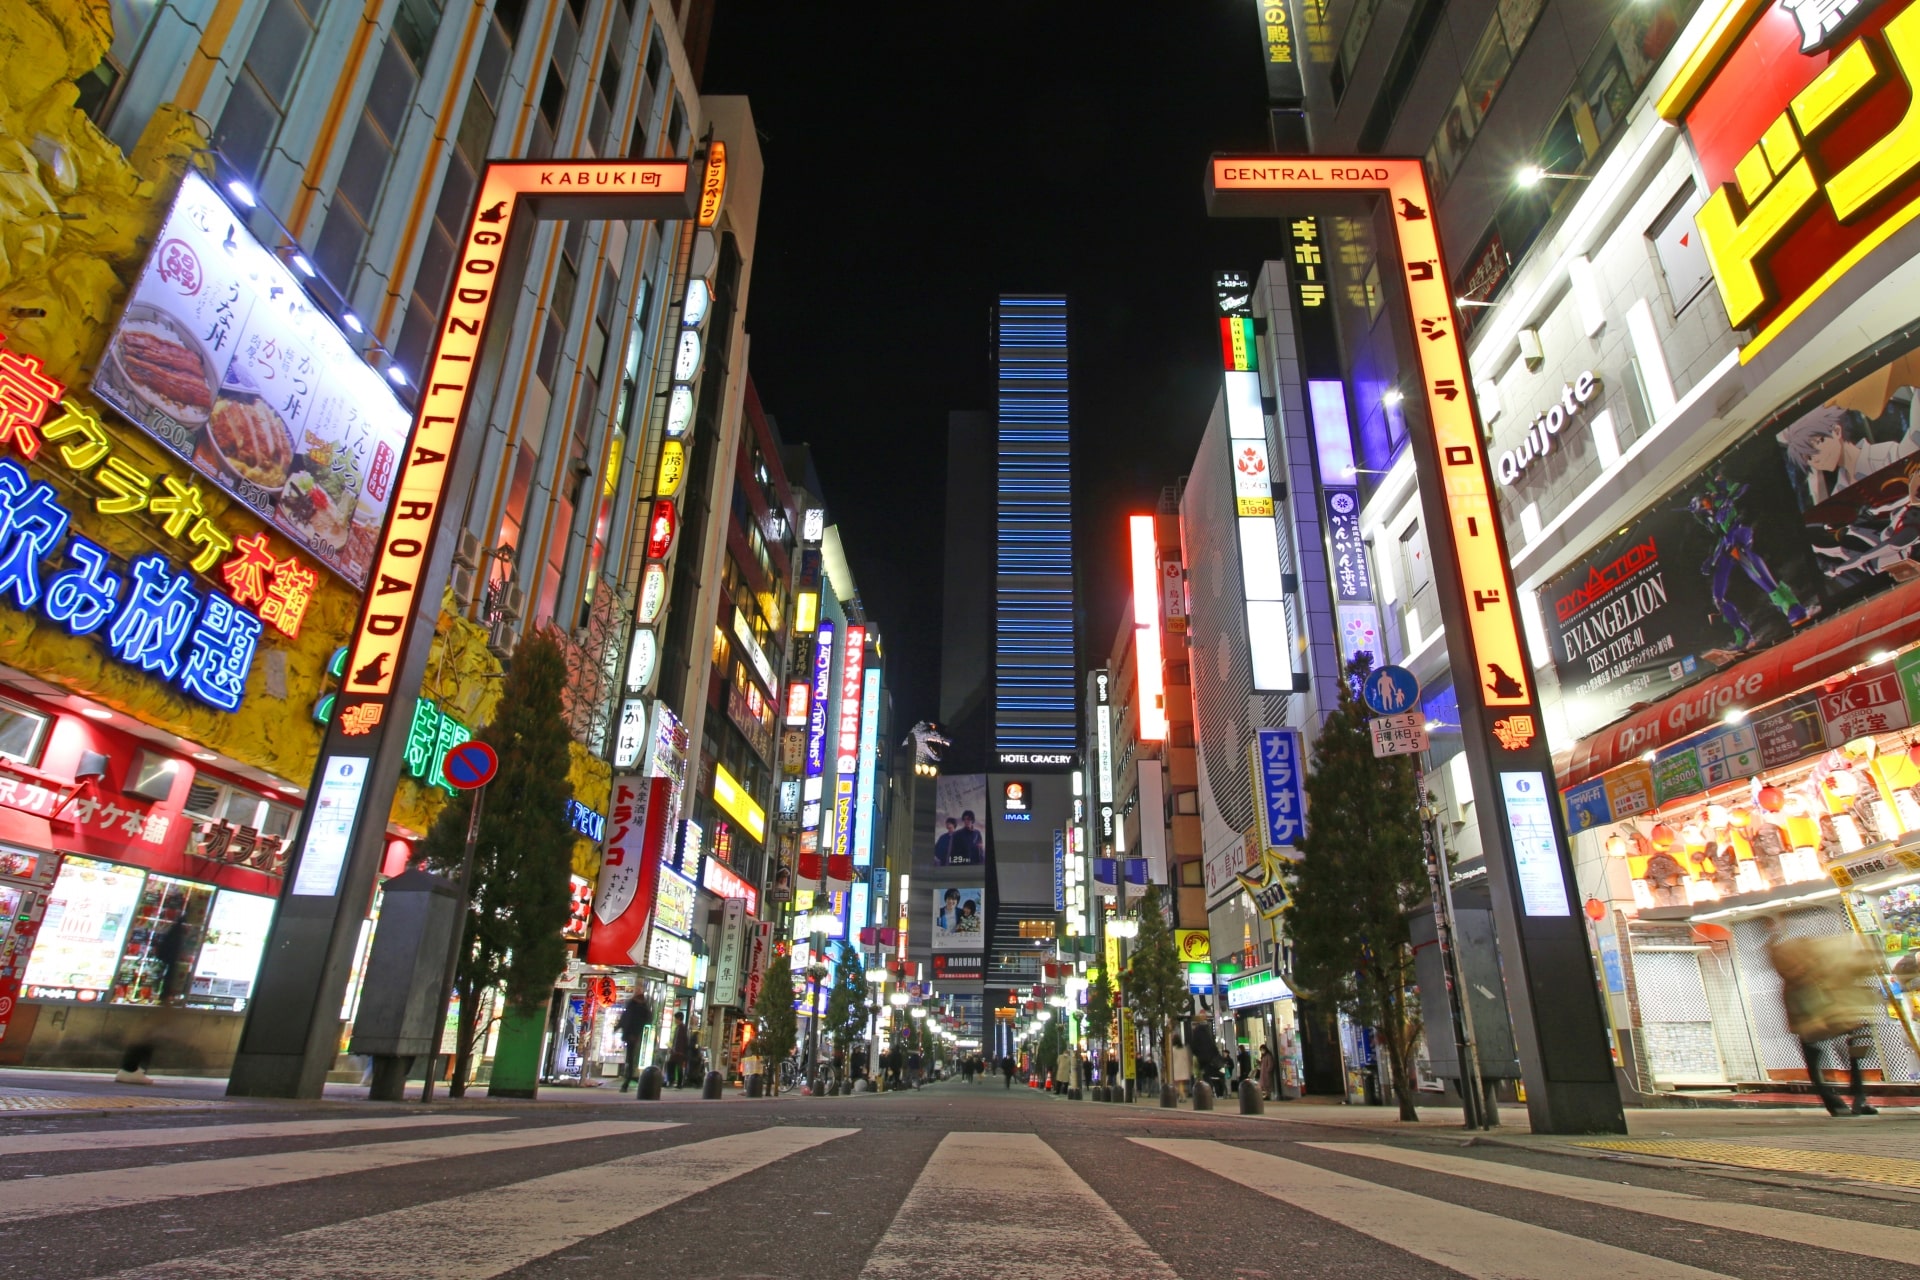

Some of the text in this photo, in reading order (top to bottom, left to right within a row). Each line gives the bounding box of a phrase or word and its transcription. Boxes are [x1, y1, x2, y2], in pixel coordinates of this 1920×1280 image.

[1224, 168, 1389, 181] CENTRAL ROAD
[205, 281, 240, 351] うな丼
[257, 338, 282, 380] かつ
[282, 357, 314, 419] かつ丼
[332, 407, 358, 472] ラーメン
[366, 231, 502, 636] GODZILLA ROAD
[1407, 259, 1500, 612] ゴジラロード
[1498, 370, 1594, 486] Quijote
[1332, 515, 1358, 596] かんかん商店
[1562, 572, 1668, 663] EVANGELION
[1587, 627, 1645, 674] TEST TYPE-01
[809, 708, 824, 759] SHINJUKU
[1618, 673, 1763, 754] Don Quijote
[1839, 712, 1889, 740] 資生堂
[1001, 754, 1072, 764] HOTEL GRACERY
[632, 779, 648, 828] 大衆酒場
[1266, 737, 1298, 841] カラオケ
[1580, 787, 1601, 803] Wi-Fi
[605, 784, 635, 867] トラノコ
[600, 872, 622, 910] やきとん
[615, 866, 634, 903] やきとり
[948, 957, 981, 967] MARUHAN
